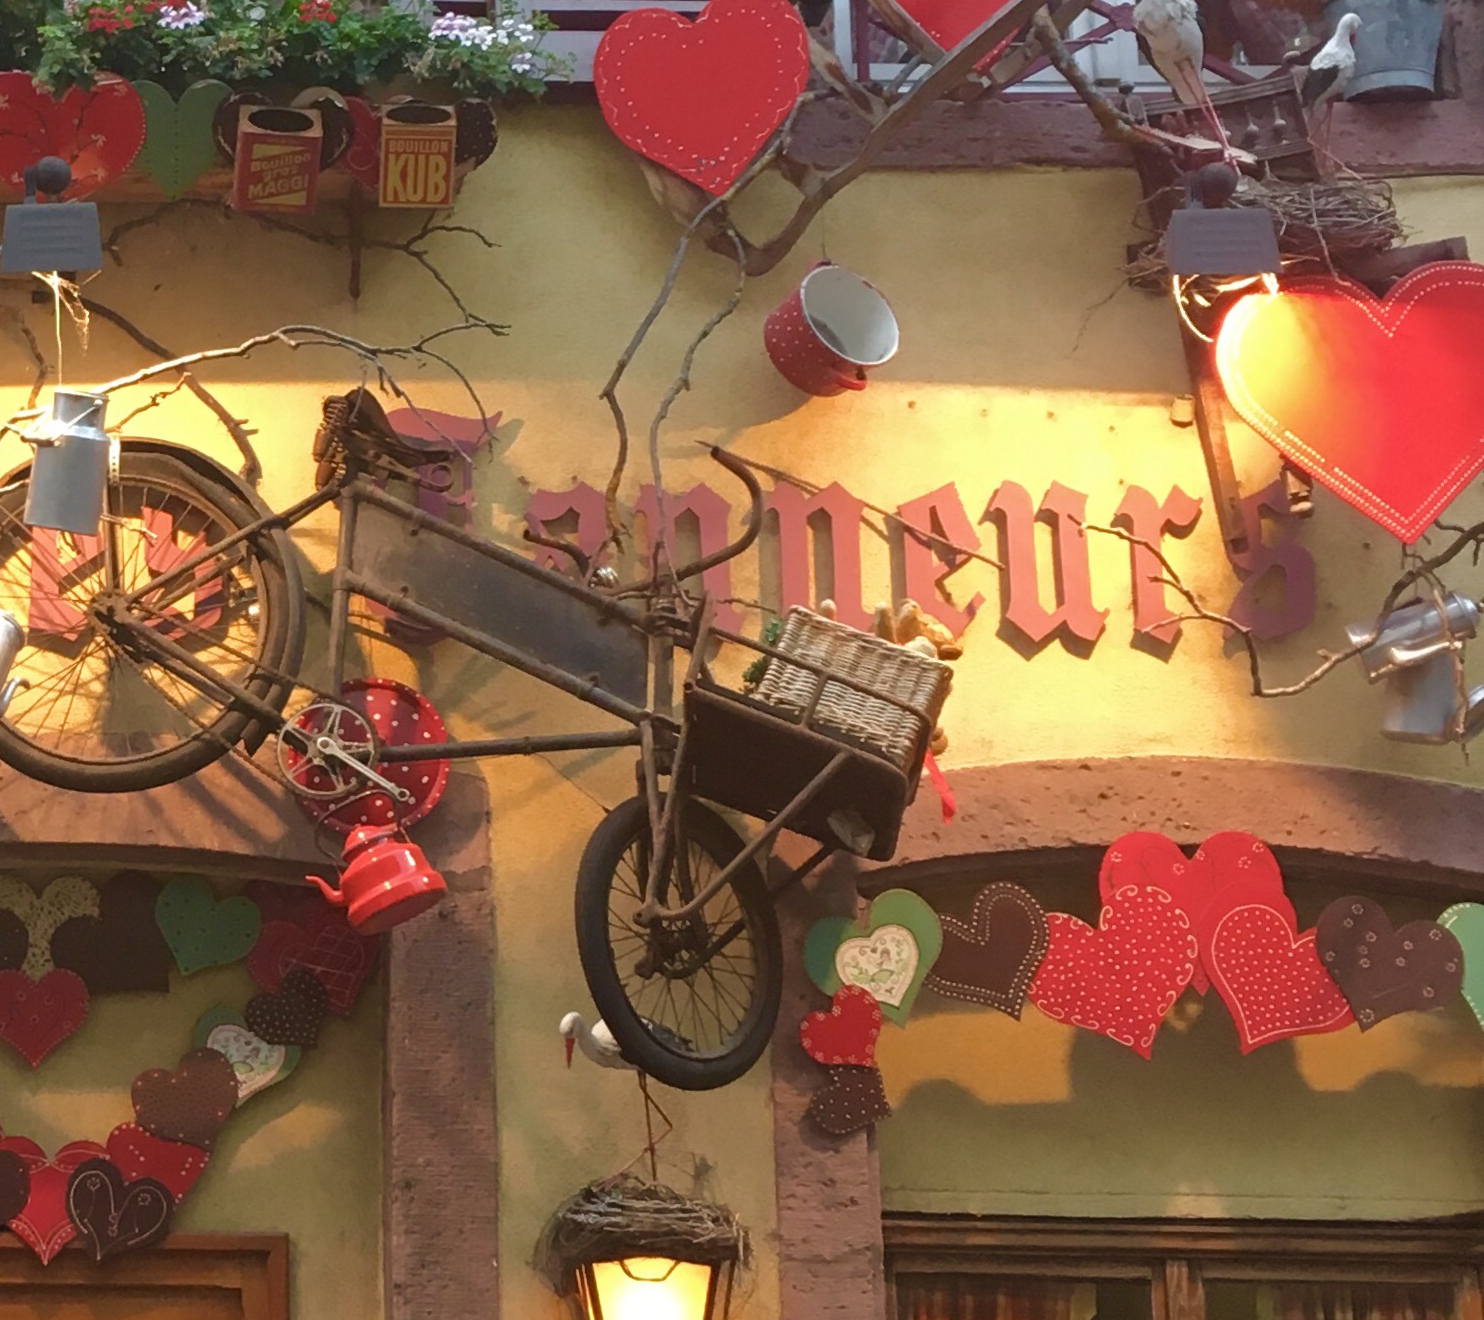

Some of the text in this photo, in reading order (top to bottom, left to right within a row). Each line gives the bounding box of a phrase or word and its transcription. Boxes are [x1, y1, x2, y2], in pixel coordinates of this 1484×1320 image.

[388, 140, 449, 153] BOUILLON
[247, 174, 310, 199] MAGGI
[388, 154, 448, 203] KUB
